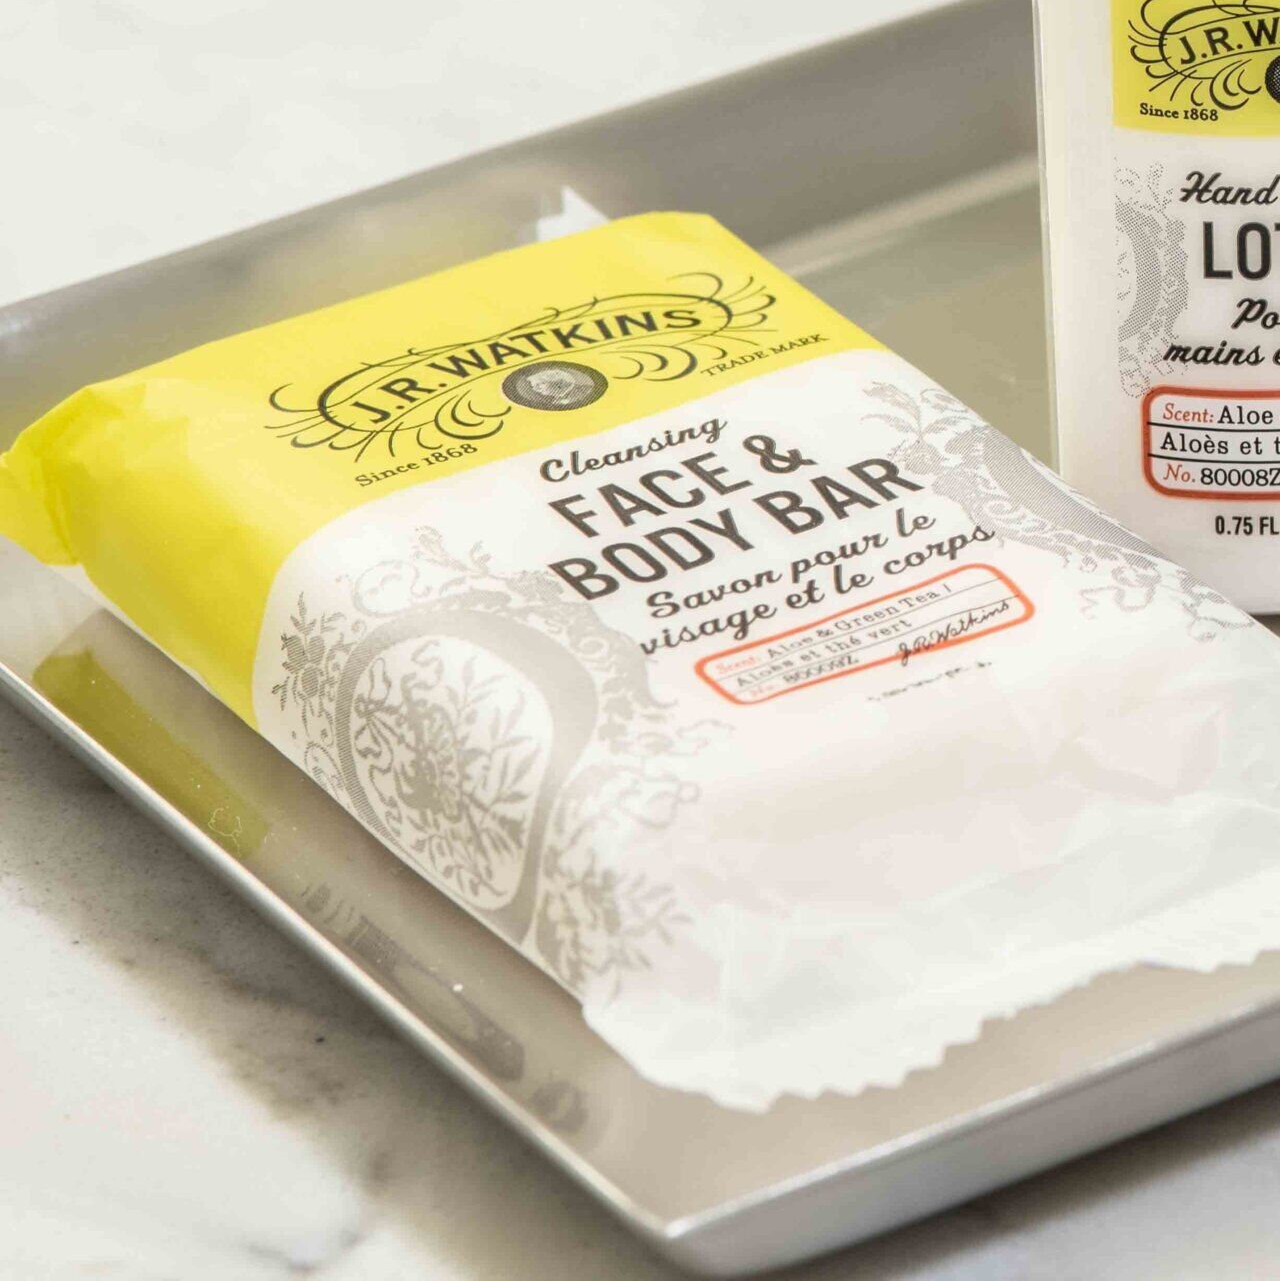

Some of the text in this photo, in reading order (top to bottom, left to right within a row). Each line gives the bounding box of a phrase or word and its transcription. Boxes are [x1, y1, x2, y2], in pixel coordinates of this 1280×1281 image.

[1139, 102, 1219, 122] Since 1868
[1179, 170, 1280, 205] Hand
[700, 334, 830, 377] TRADE MARK
[1163, 341, 1264, 366] mains
[1162, 403, 1215, 424] Scent:
[1217, 405, 1274, 426] Aloe
[355, 443, 478, 487] Since 1868
[538, 416, 729, 483] Cleansing
[1160, 433, 1230, 456] Aloès
[1239, 435, 1264, 456] et
[547, 433, 815, 539] FACE &
[1163, 463, 1197, 484] No.
[547, 457, 926, 602] BODY BAR
[1215, 515, 1253, 536] 0.75
[646, 506, 937, 619] Savon pour le
[640, 523, 996, 655] visage et le corps
[766, 633, 814, 659] Aloe
[835, 604, 898, 634] Green
[898, 589, 939, 610] Tea
[799, 649, 822, 663] et
[867, 619, 914, 642] vert
